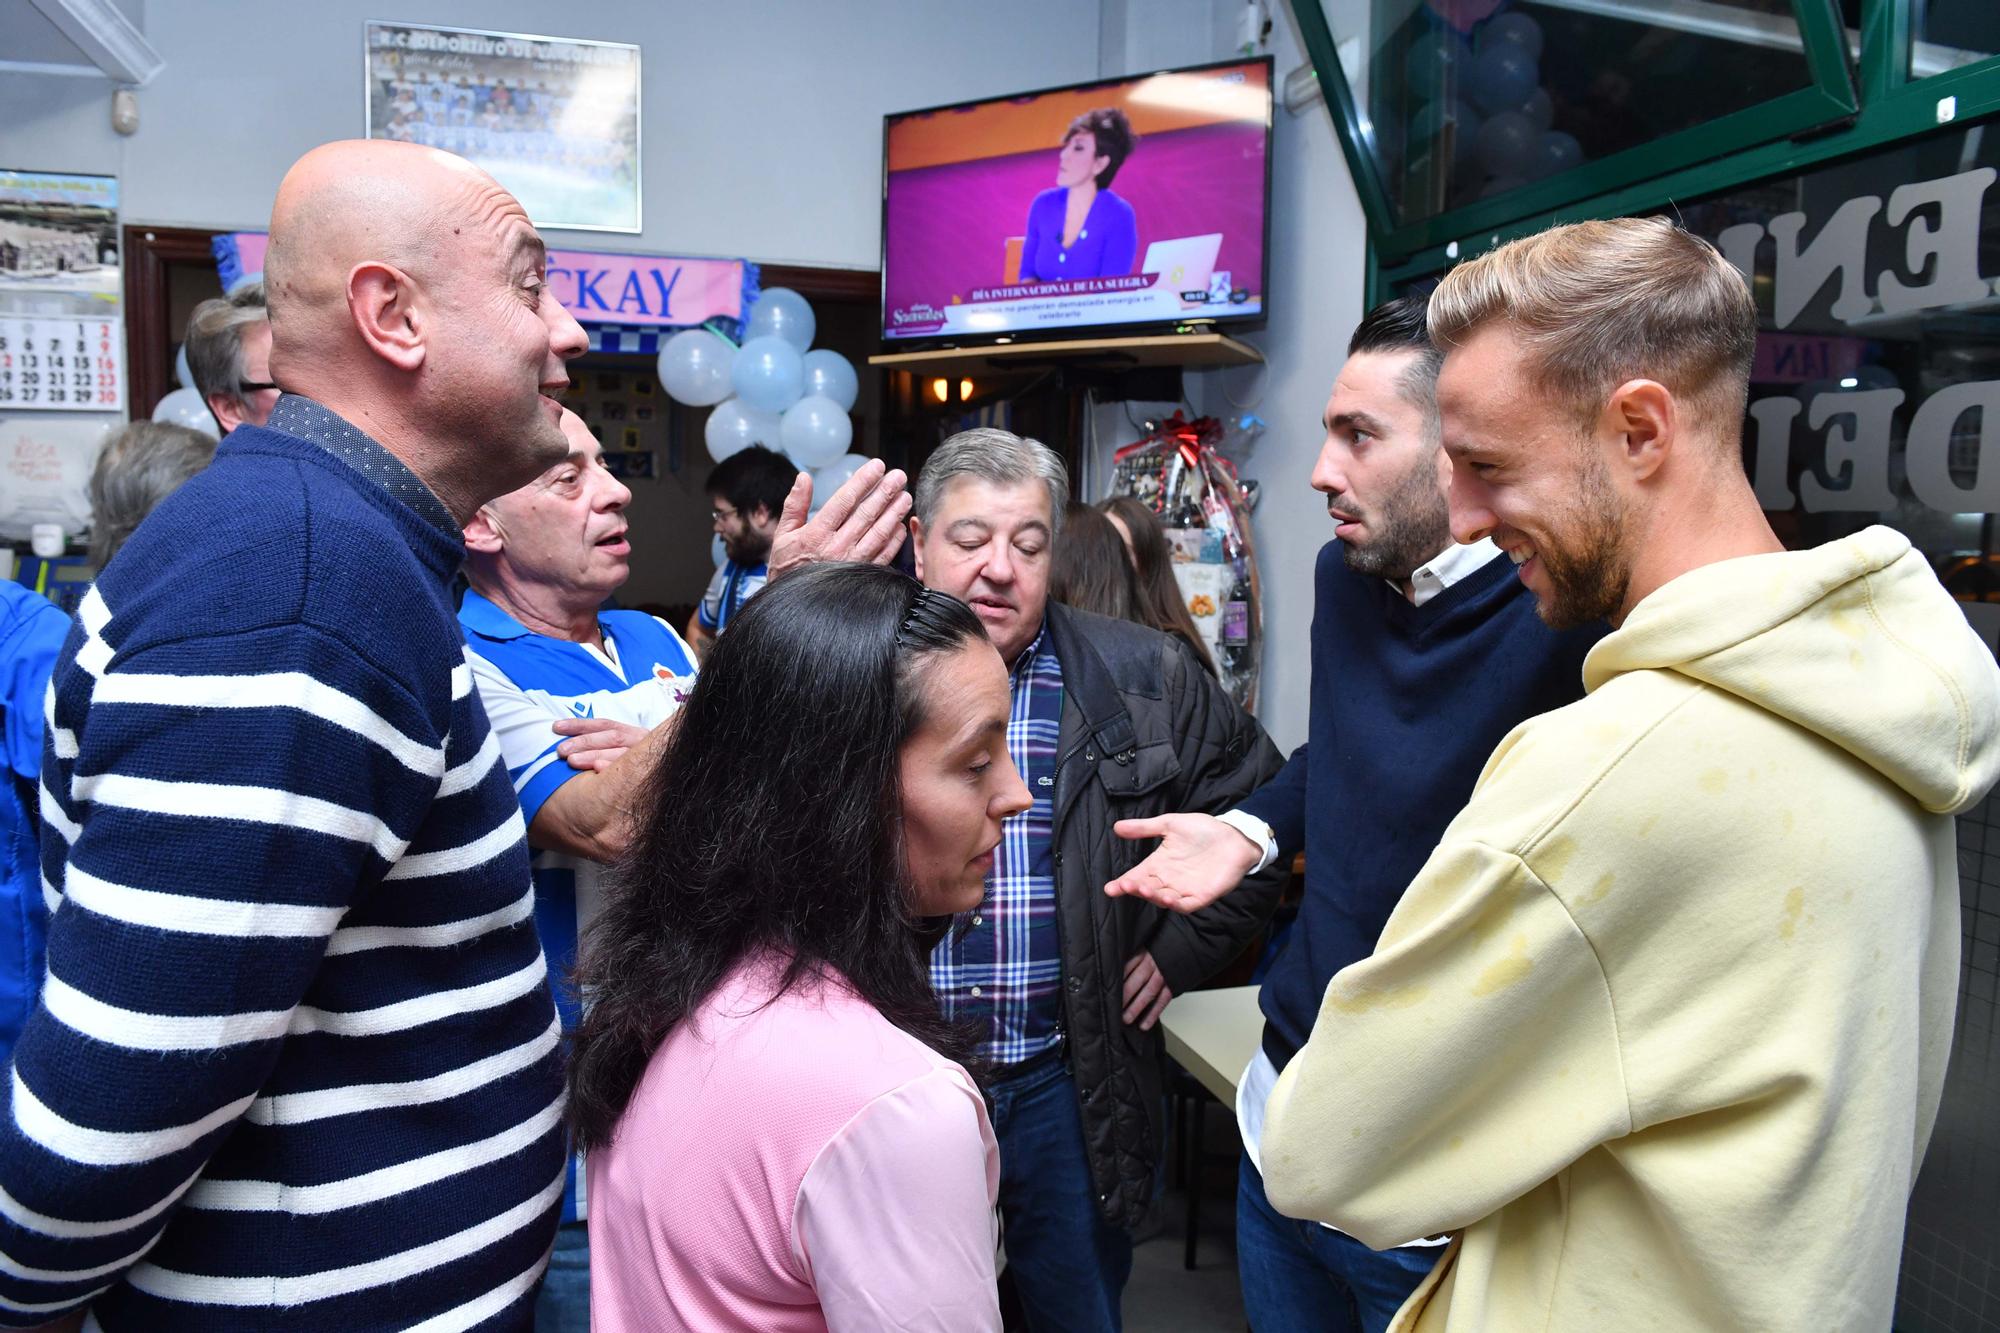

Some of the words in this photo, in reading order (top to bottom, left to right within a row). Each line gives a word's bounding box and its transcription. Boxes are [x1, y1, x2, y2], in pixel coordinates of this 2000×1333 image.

[991, 283, 1071, 299] INTERNACIONAL
[1073, 281, 1088, 292] DE
[1089, 280, 1103, 291] LA
[1105, 276, 1149, 289] SUEGRA
[78, 323, 84, 336] 1
[101, 324, 109, 337] 2
[24, 338, 33, 351] 6
[50, 338, 60, 351] 7
[77, 340, 85, 353] 8
[101, 340, 109, 352] 9
[21, 354, 38, 368] 13
[48, 355, 64, 368] 14
[74, 356, 90, 369] 15
[97, 356, 114, 370] 16
[21, 371, 40, 385] 20
[48, 372, 65, 385] 21
[74, 373, 92, 386] 22
[98, 372, 116, 387] 23
[21, 388, 39, 401] 27
[48, 388, 66, 402] 28
[74, 389, 92, 402] 29
[98, 389, 117, 404] 30
